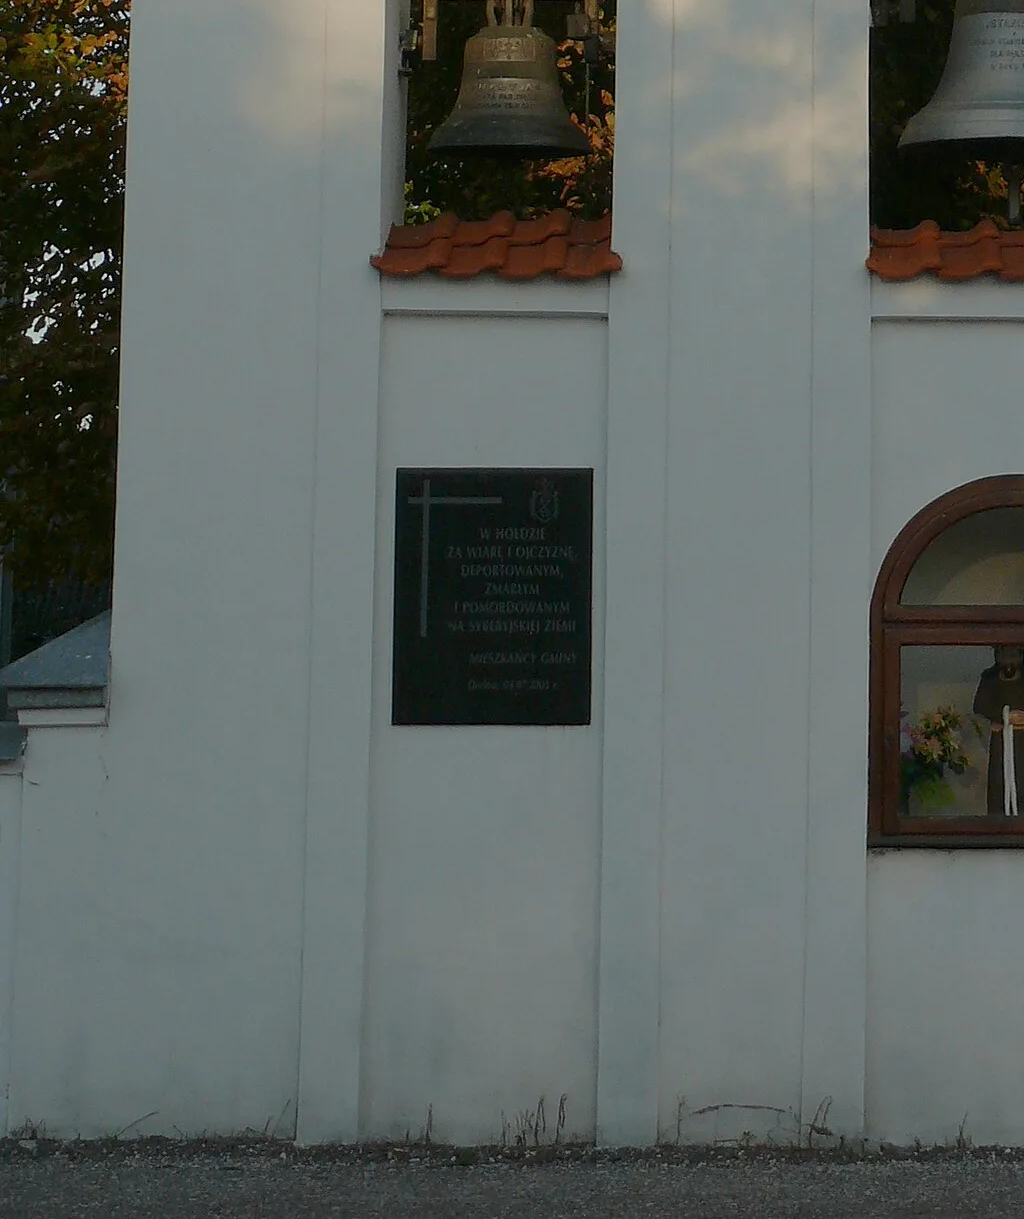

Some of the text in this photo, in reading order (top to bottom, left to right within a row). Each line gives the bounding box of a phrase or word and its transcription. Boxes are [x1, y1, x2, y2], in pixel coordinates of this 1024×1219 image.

[479, 526, 546, 540] W HOŁDZIE
[447, 545, 463, 559] ZA
[466, 545, 503, 562] WIARĘ
[484, 582, 540, 595] ZMARŁYM
[462, 600, 570, 614] POMORDOWANYM
[447, 619, 465, 632] NA
[544, 619, 576, 632] ZIEMI
[540, 651, 578, 665] GMINY
